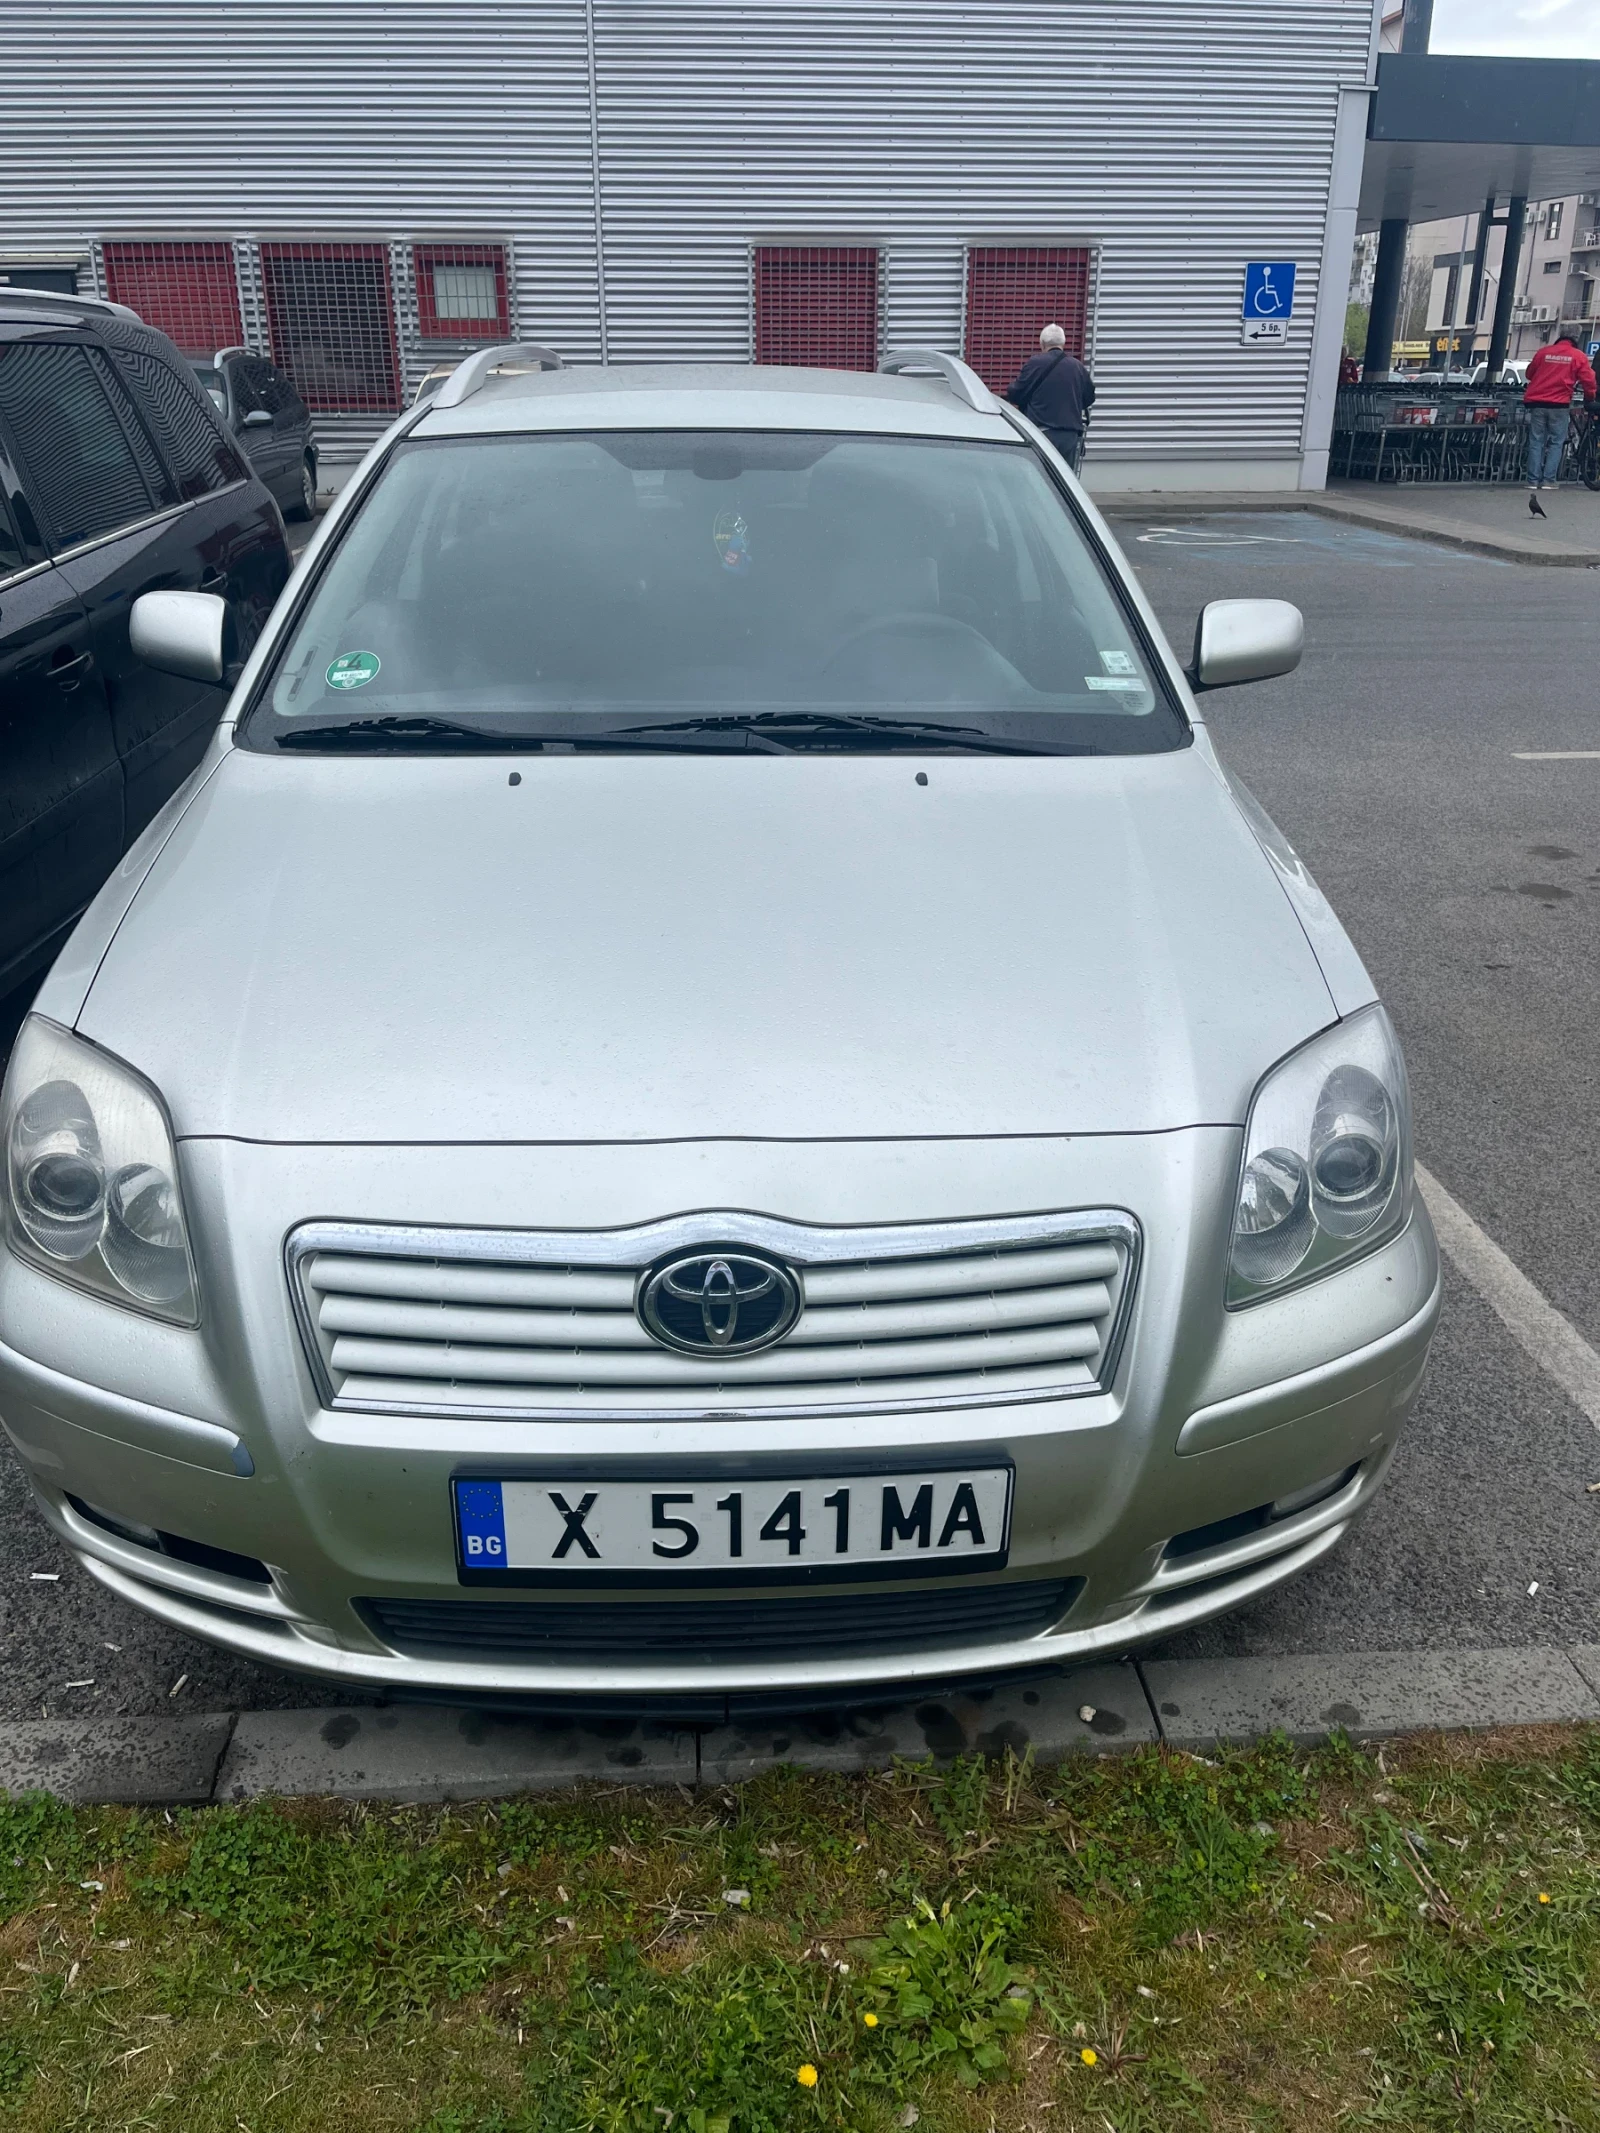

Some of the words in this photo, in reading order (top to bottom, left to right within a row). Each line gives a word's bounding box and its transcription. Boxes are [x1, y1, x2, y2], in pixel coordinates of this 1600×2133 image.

[1261, 323, 1266, 331] 5
[1591, 343, 1600, 356] P
[347, 654, 361, 669] 4
[548, 1490, 602, 1558] X
[651, 1486, 850, 1558] 5141
[880, 1480, 986, 1550] MA
[467, 1535, 502, 1555] BG
